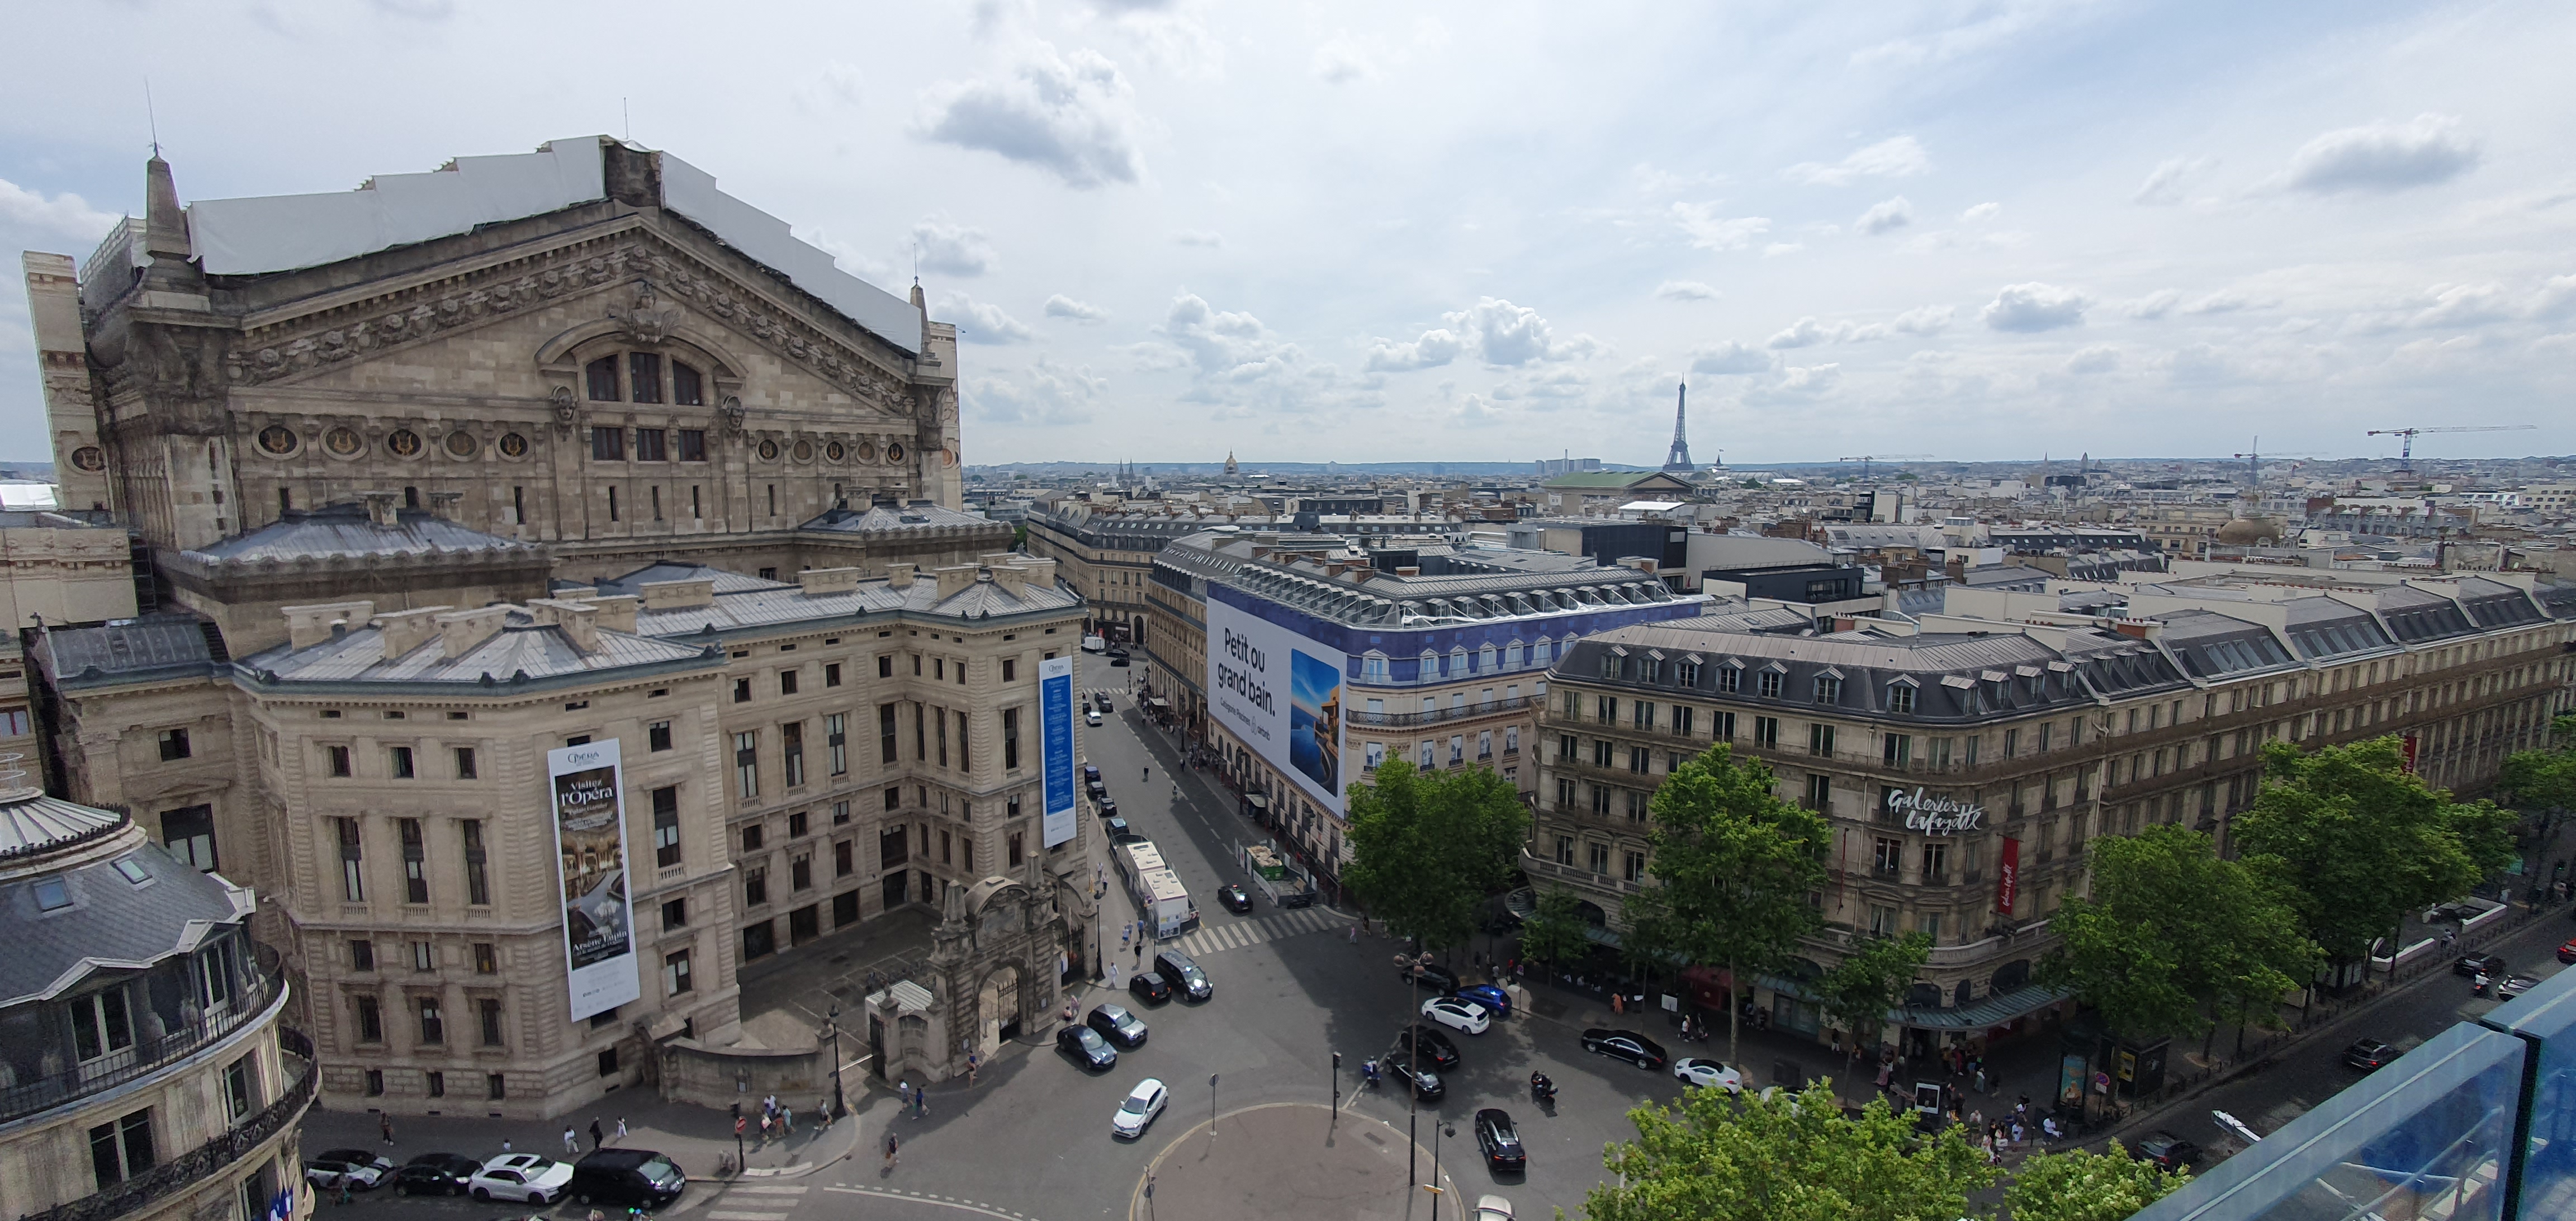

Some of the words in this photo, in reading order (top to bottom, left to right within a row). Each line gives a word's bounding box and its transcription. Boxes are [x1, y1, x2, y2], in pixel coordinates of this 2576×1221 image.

[1225, 627, 1249, 665] Petit
[1251, 647, 1265, 673] ou
[1218, 662, 1247, 698] grand
[1248, 672, 1276, 717] bain.
[1257, 725, 1271, 741] airbnb
[561, 785, 614, 807] l'Opéra
[1888, 787, 1958, 813] Galeries
[1905, 804, 1986, 836] Lafayette
